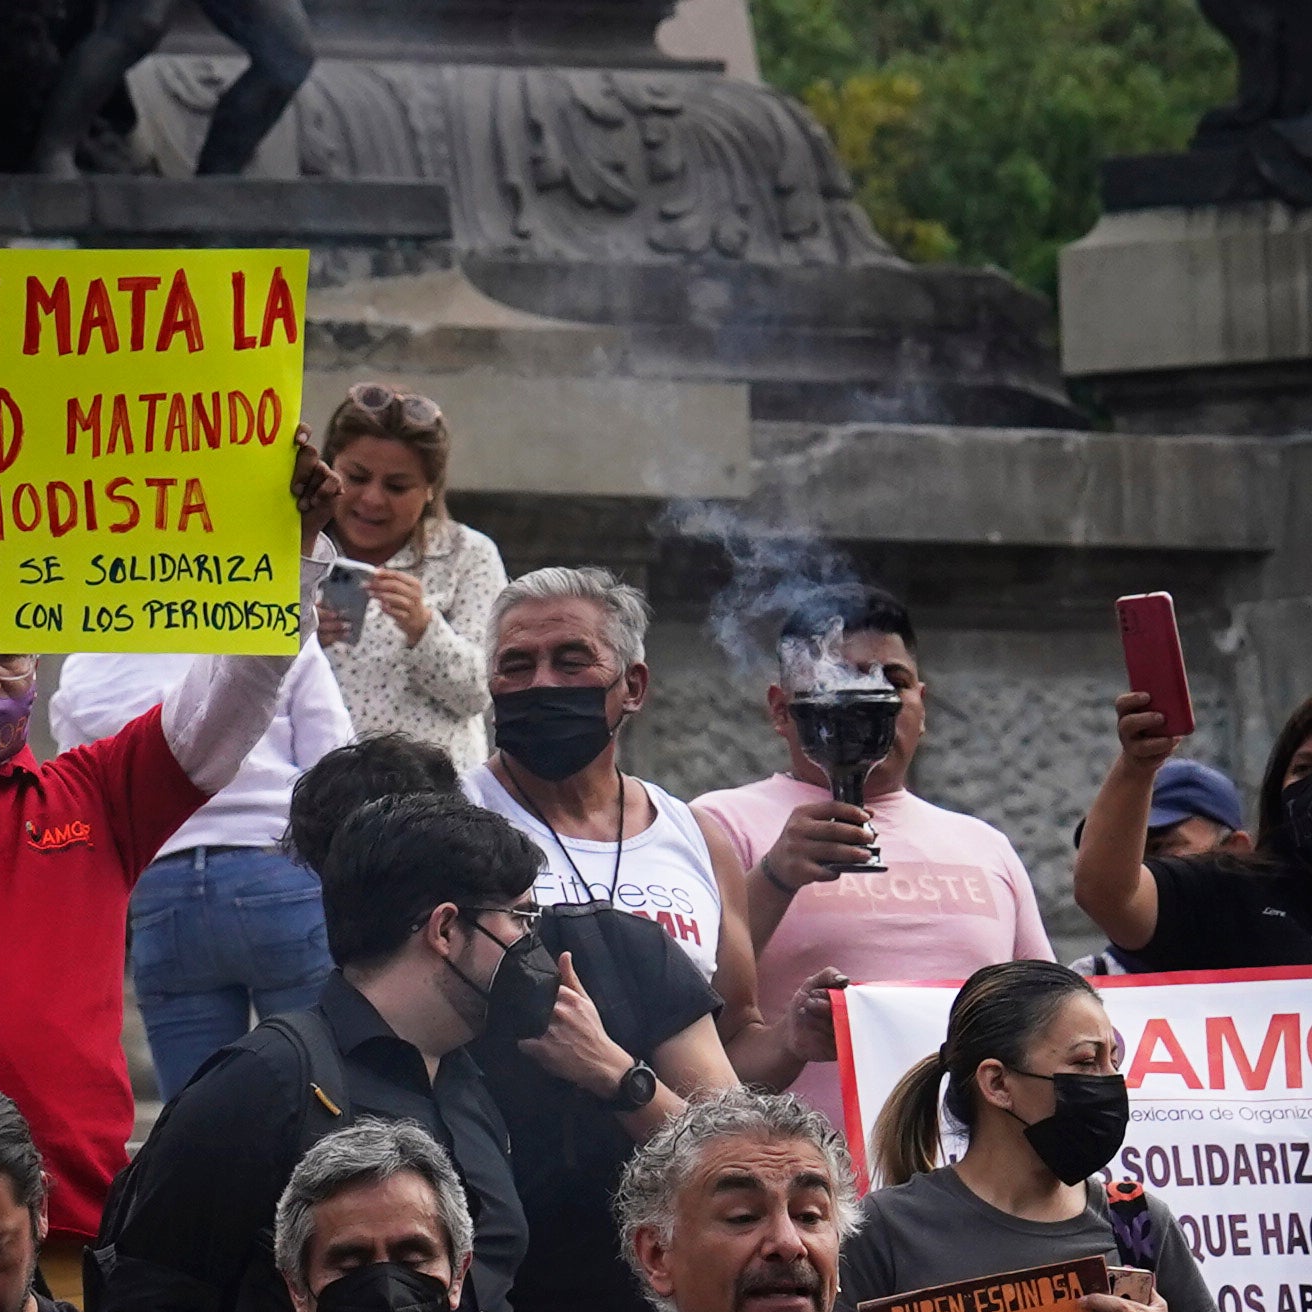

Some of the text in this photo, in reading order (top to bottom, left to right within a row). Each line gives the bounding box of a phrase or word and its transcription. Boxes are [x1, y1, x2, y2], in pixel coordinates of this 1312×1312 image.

[21, 267, 205, 356] MATA
[231, 265, 298, 351] LA
[66, 386, 282, 459] MATANDO
[19, 551, 275, 586] SE SOLIDARIZA
[15, 599, 301, 640] CON LOS PERIODISTAS
[813, 871, 987, 904] LACOSTE
[1126, 1012, 1312, 1092] AM
[1129, 1104, 1205, 1122] exicana
[1209, 1106, 1235, 1121] de
[1178, 1212, 1312, 1264] QUE HA
